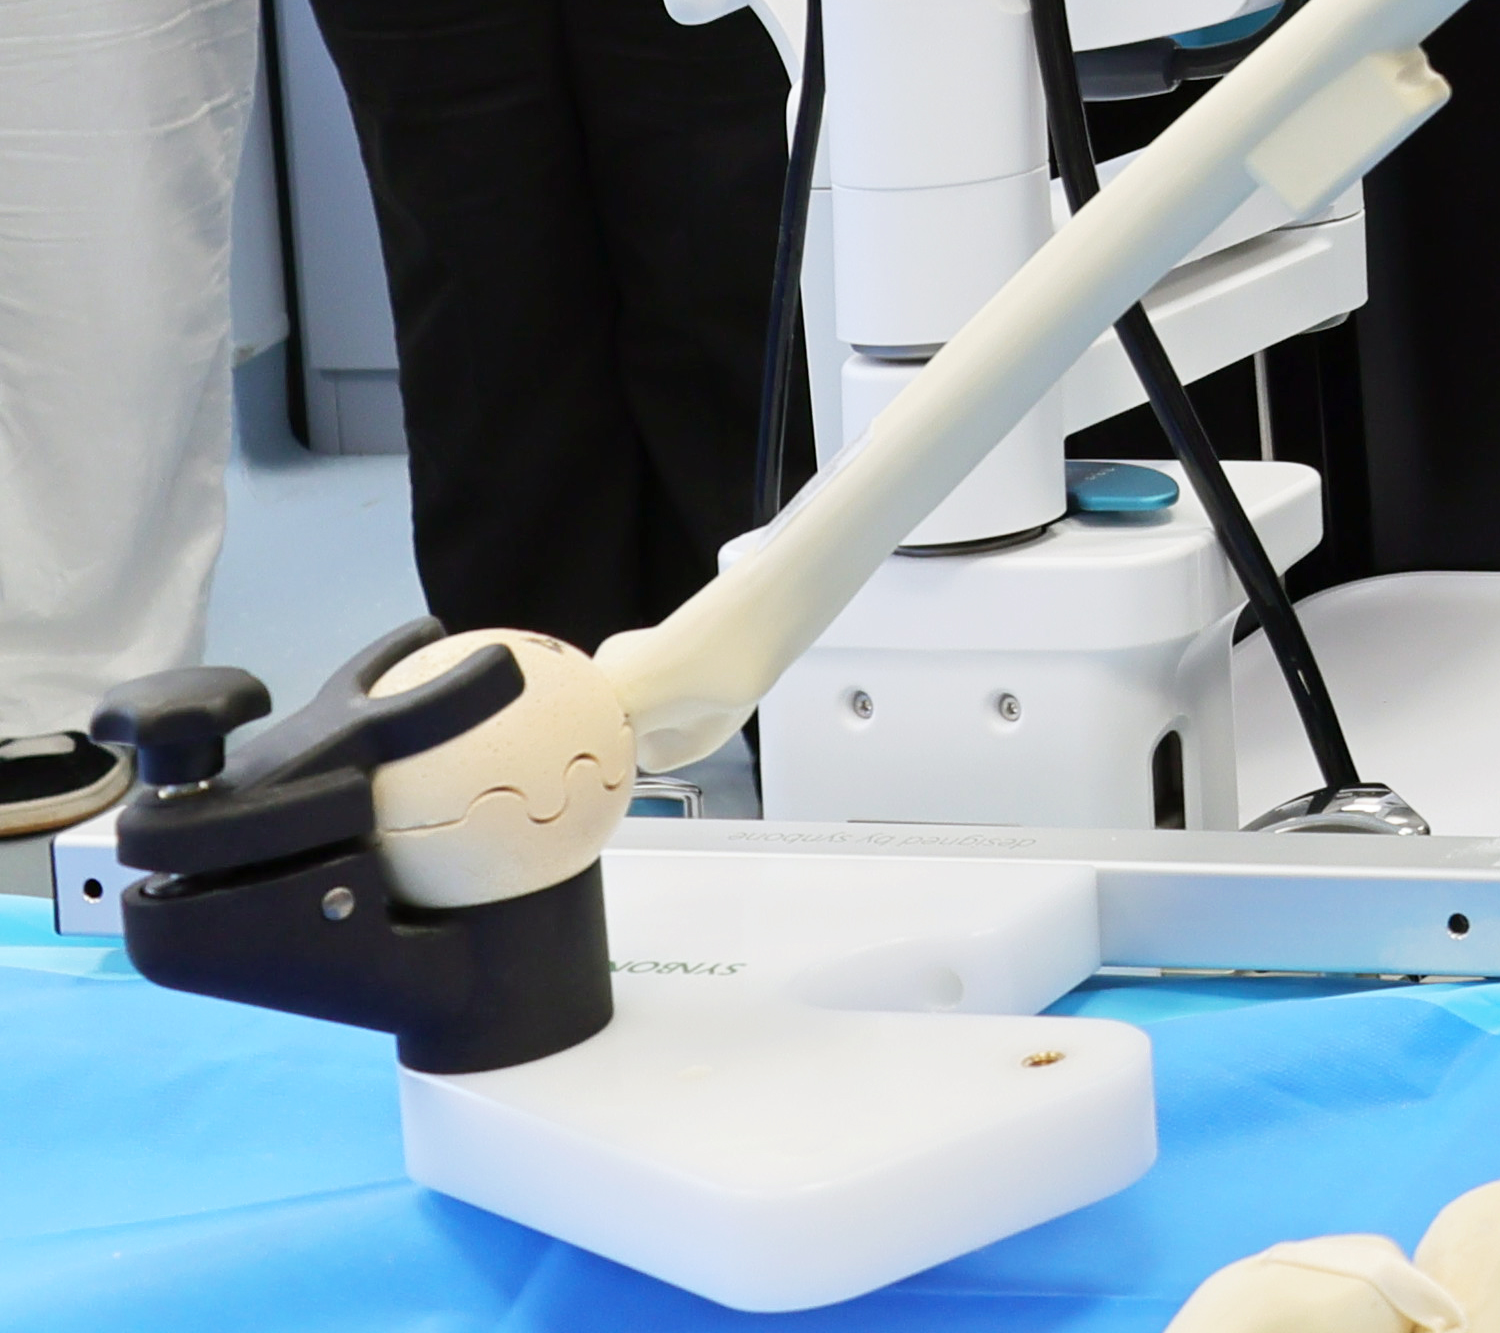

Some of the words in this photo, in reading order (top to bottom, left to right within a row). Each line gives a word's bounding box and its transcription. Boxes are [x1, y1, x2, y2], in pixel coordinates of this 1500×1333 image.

[729, 831, 848, 844] synbone
[856, 833, 893, 847] by
[903, 835, 1037, 850] designed
[609, 960, 748, 976] SYNBON
